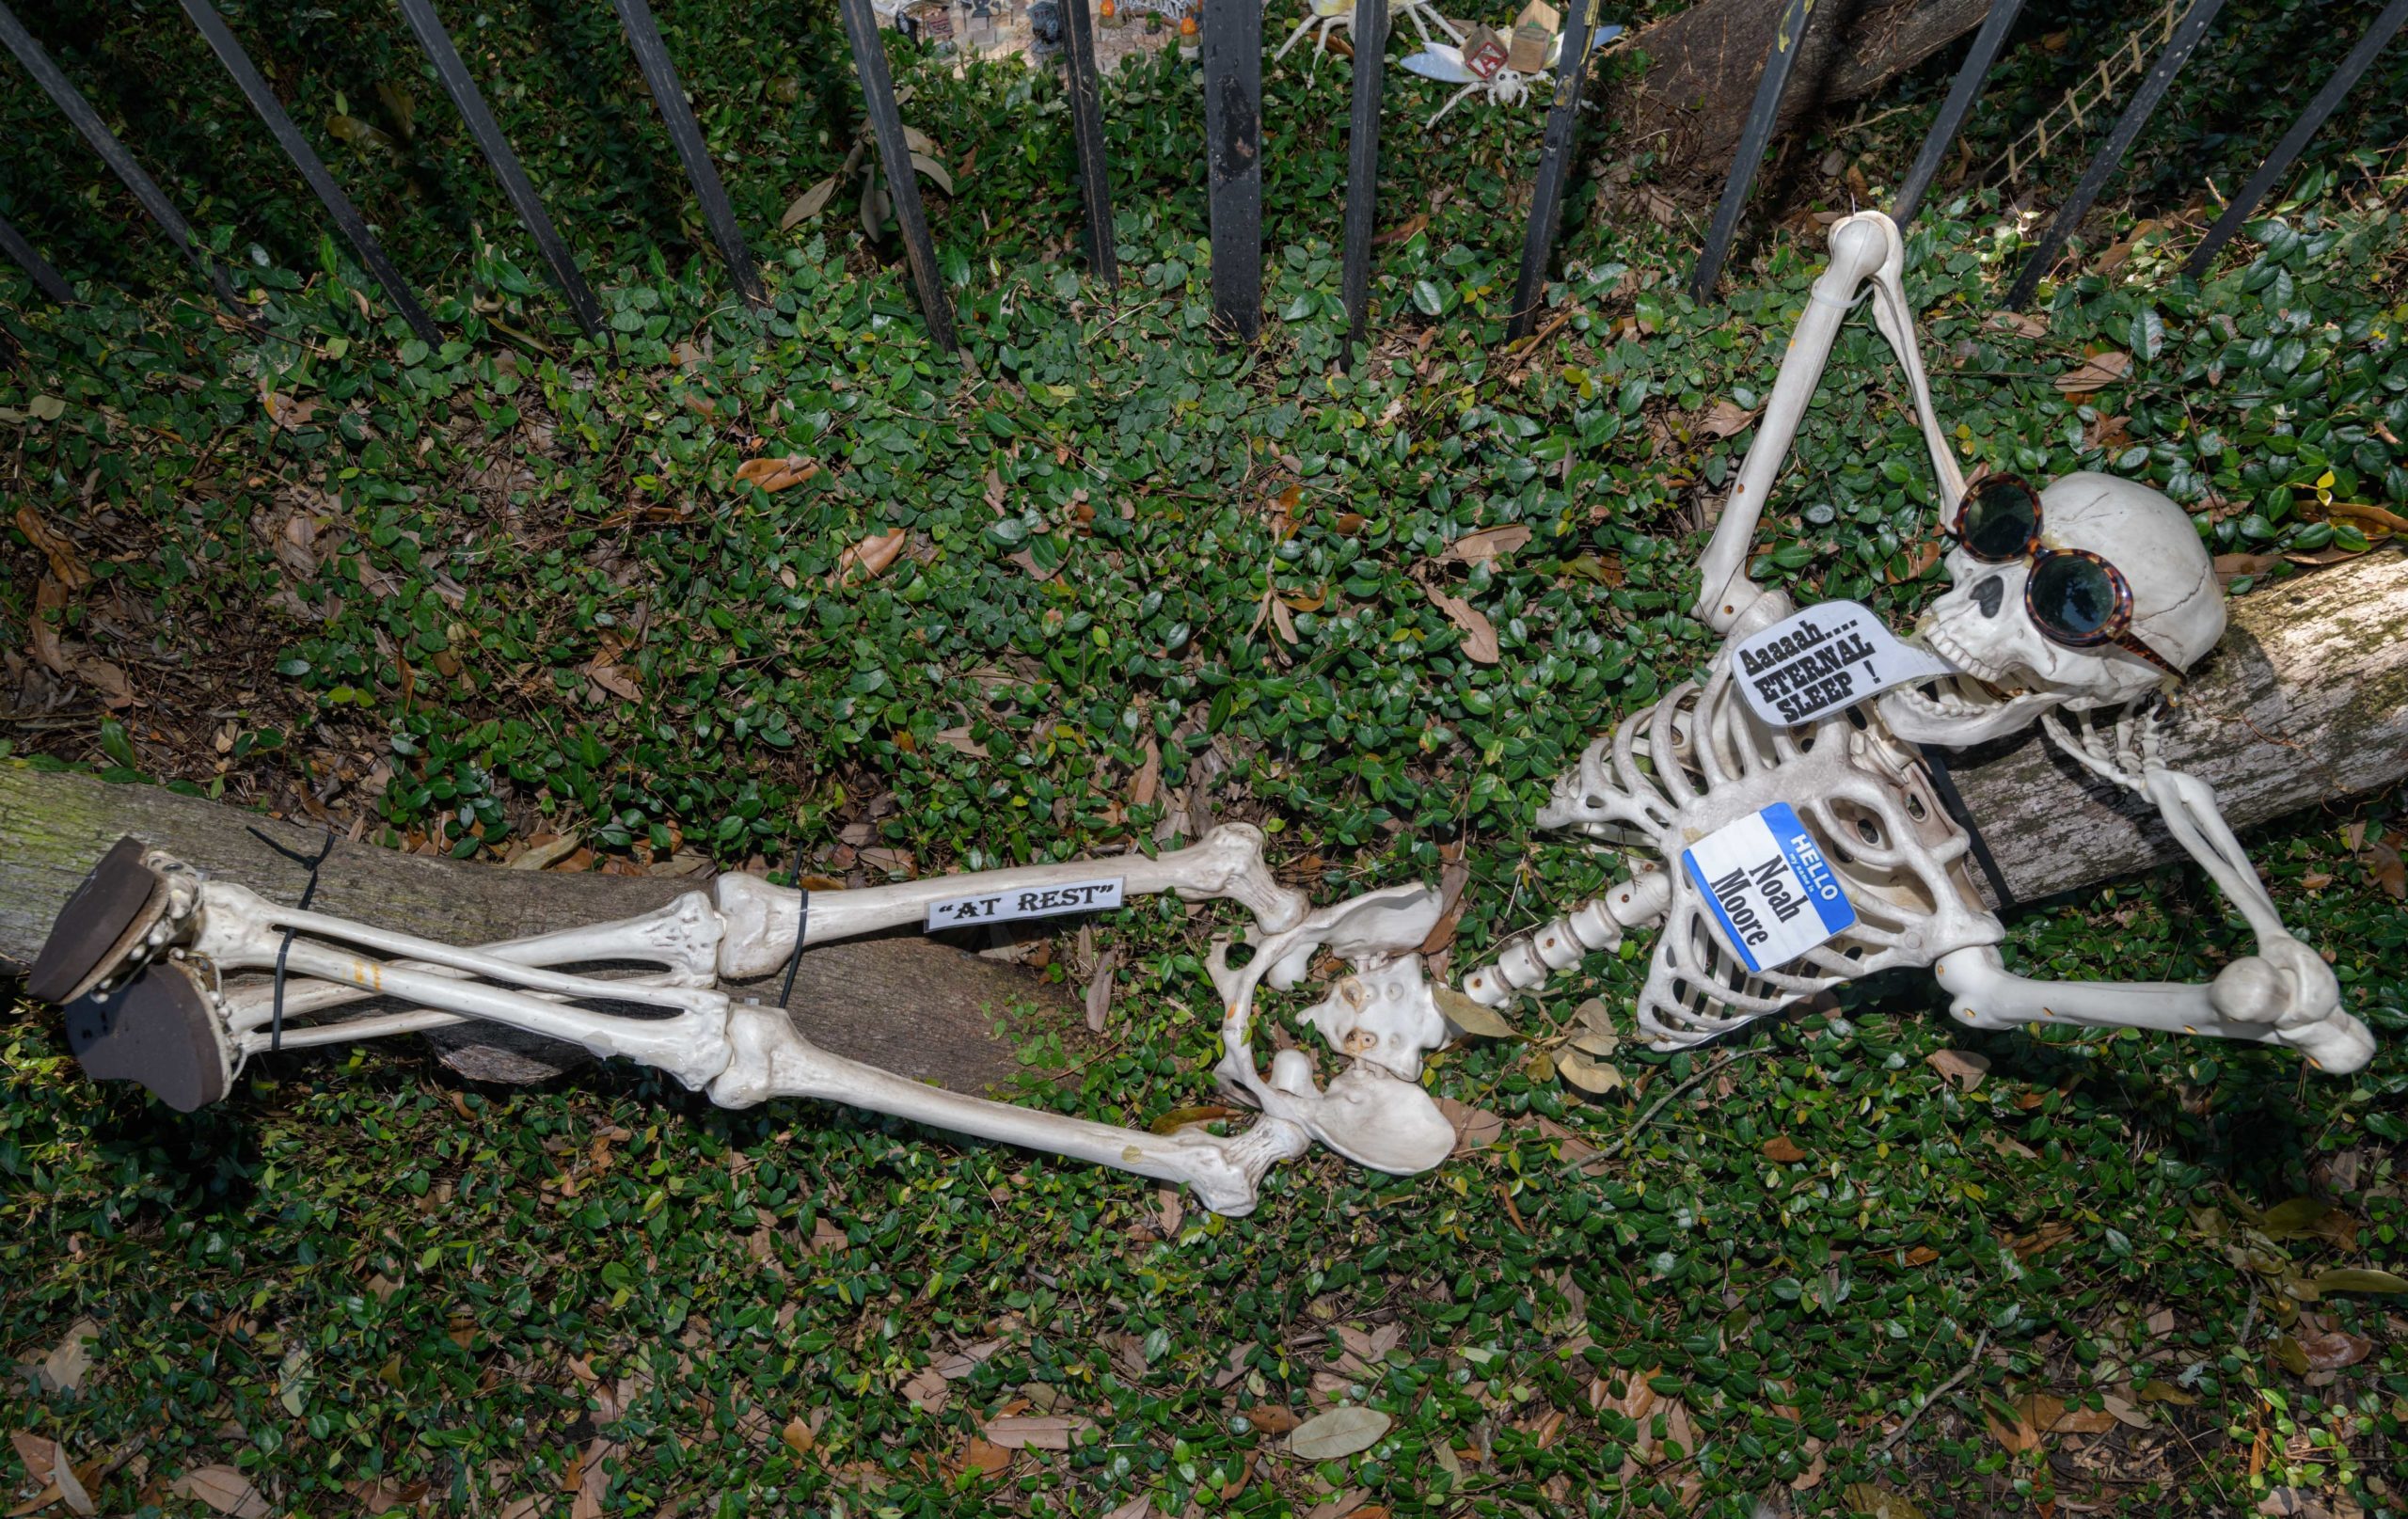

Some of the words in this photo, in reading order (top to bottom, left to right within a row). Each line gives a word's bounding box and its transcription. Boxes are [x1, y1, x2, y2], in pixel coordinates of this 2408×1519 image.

[1480, 53, 1500, 75] A
[1753, 632, 1876, 704] ETERNAL
[1776, 671, 1854, 723] SLEEP
[1749, 854, 1809, 924] Noah
[1789, 853, 1798, 865] my
[1796, 865, 1811, 885] name
[1807, 884, 1814, 893] is
[1790, 833, 1839, 900] HELLO
[1709, 867, 1769, 946] Moore
